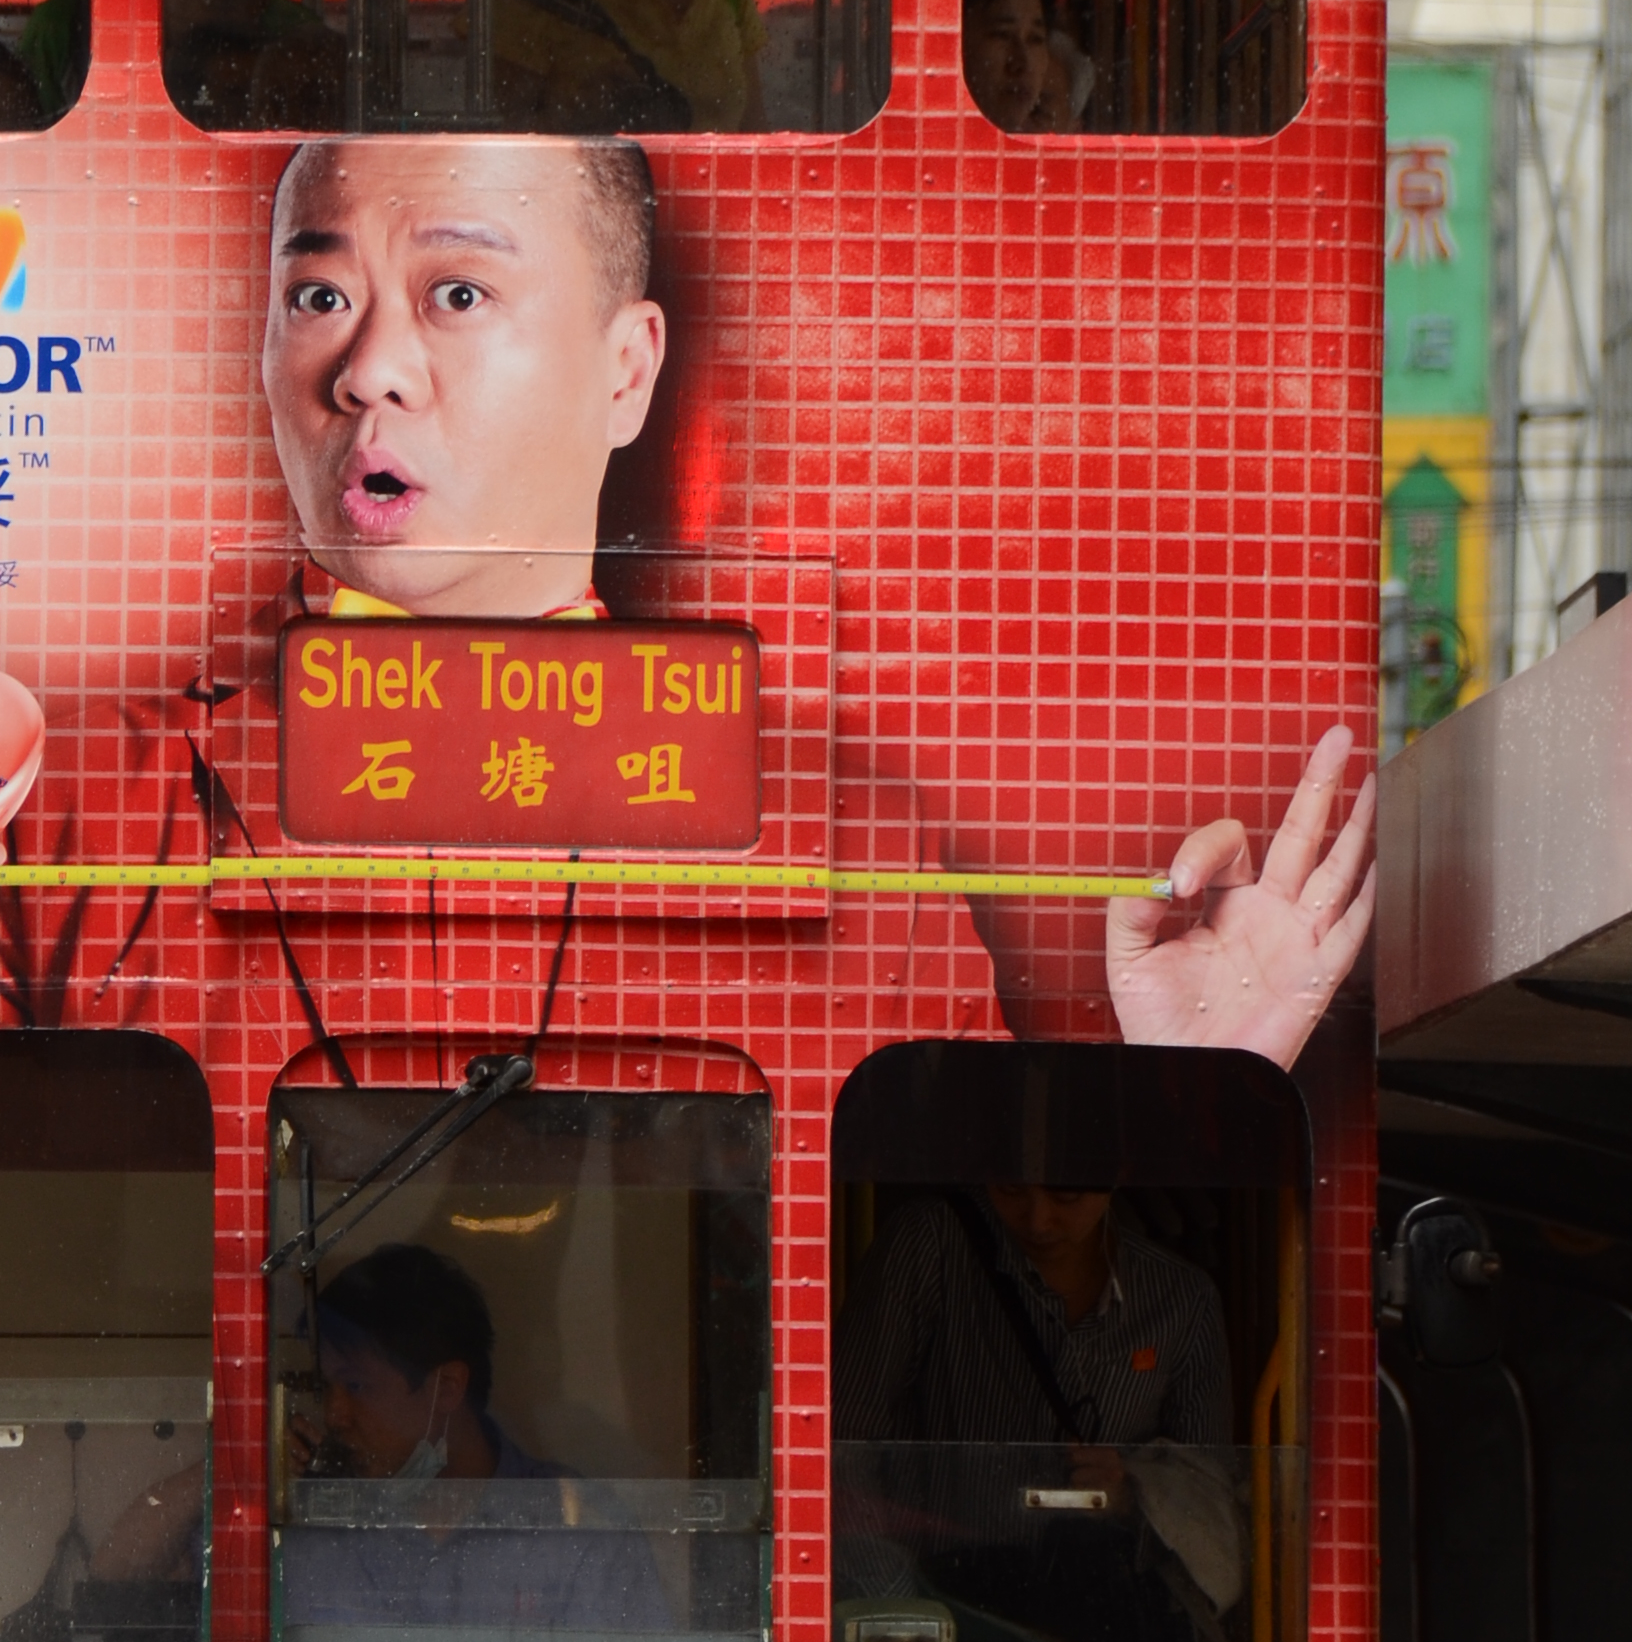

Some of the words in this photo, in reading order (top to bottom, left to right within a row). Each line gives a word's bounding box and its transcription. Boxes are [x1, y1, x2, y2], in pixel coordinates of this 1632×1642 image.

[298, 637, 444, 710] Shek
[469, 641, 604, 728] Tong
[630, 643, 743, 715] Tsui
[340, 737, 697, 808] 石塘咀
